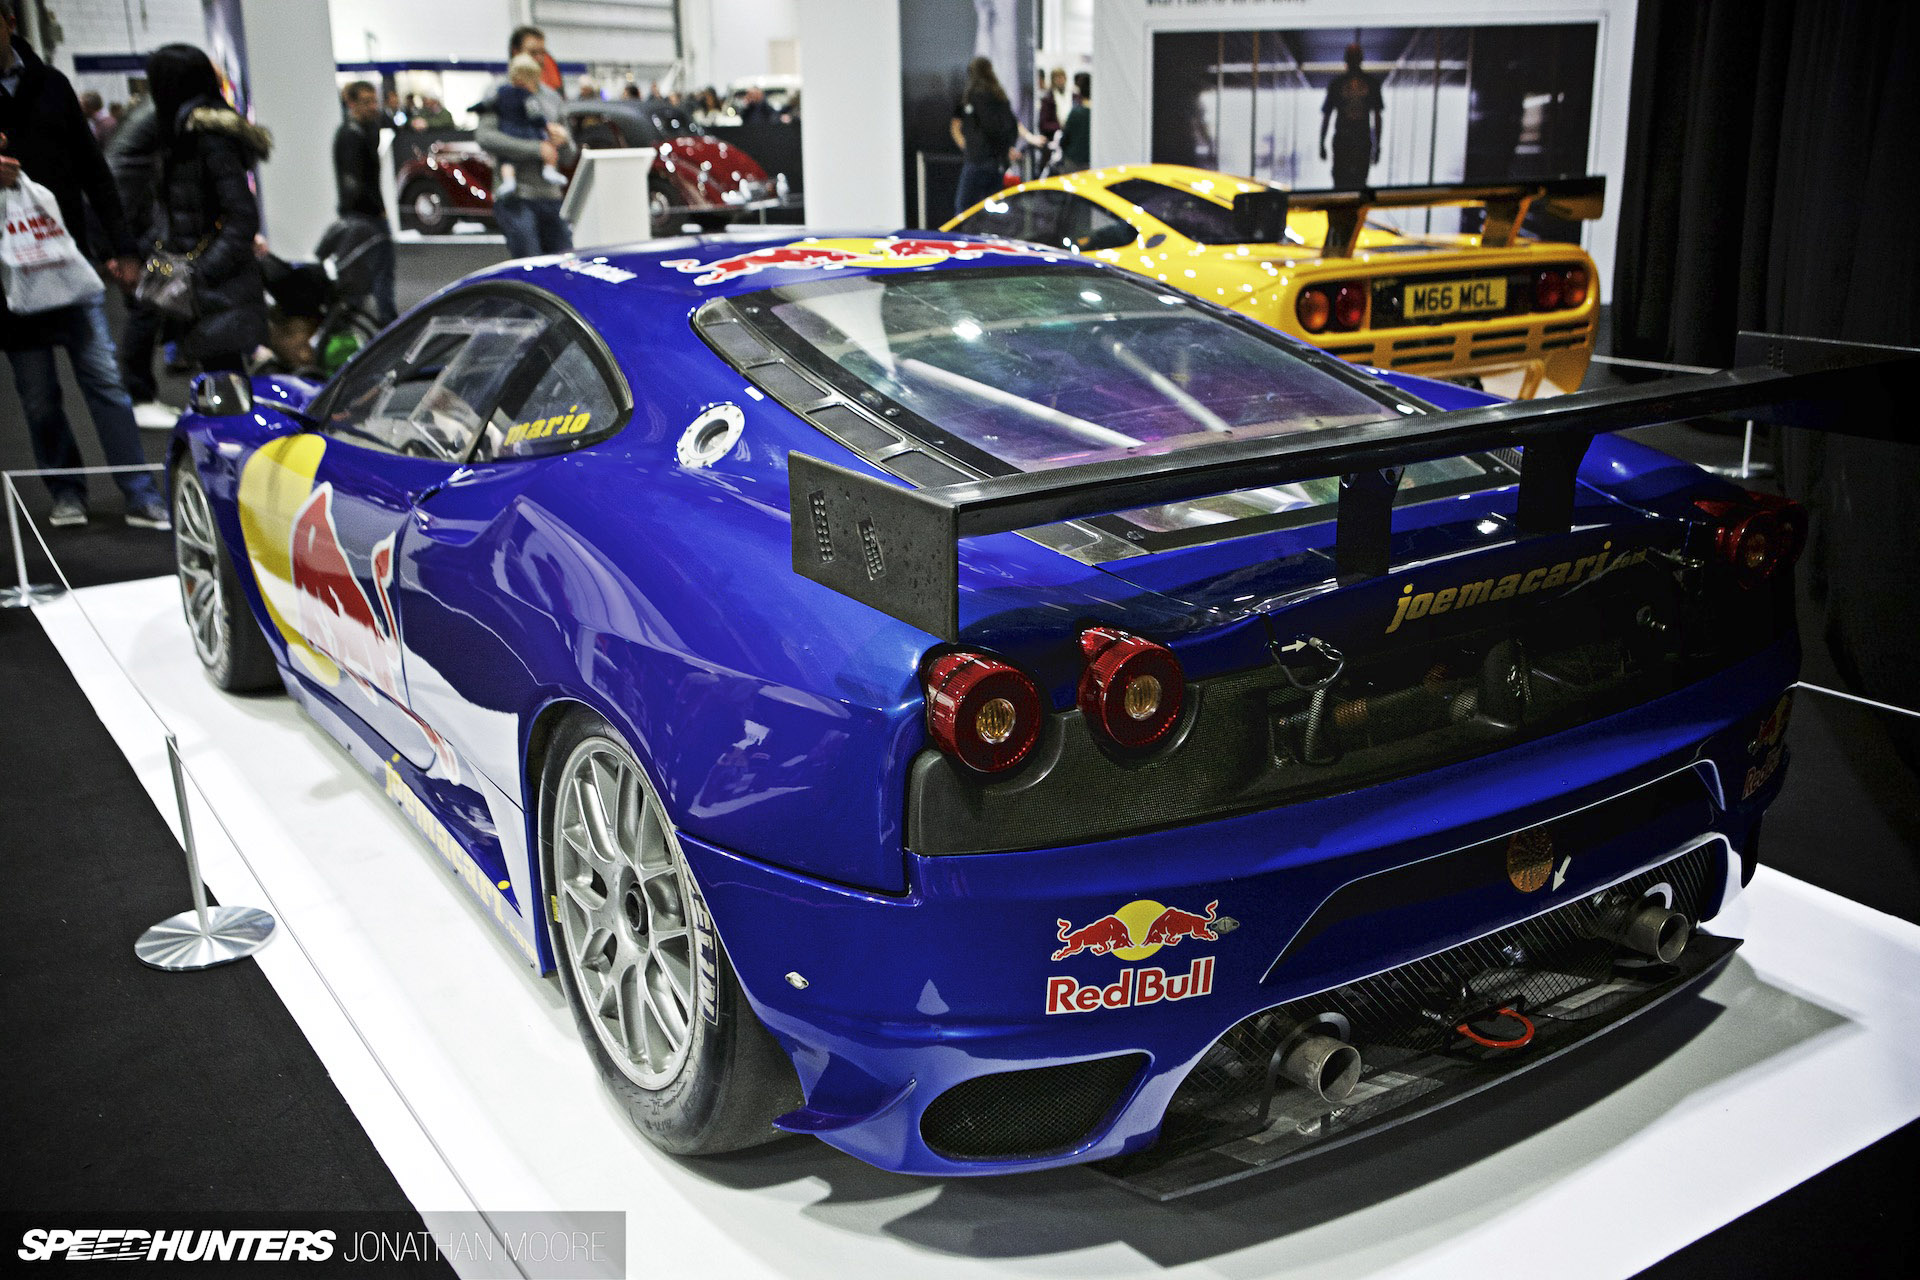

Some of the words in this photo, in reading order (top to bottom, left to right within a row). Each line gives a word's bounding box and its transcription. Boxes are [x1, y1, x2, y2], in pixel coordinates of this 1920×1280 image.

[1413, 286, 1453, 313] M66
[1459, 282, 1498, 307] MCL
[503, 404, 591, 447] mario
[1046, 968, 1134, 1015] Red
[1134, 956, 1215, 1006] Bull
